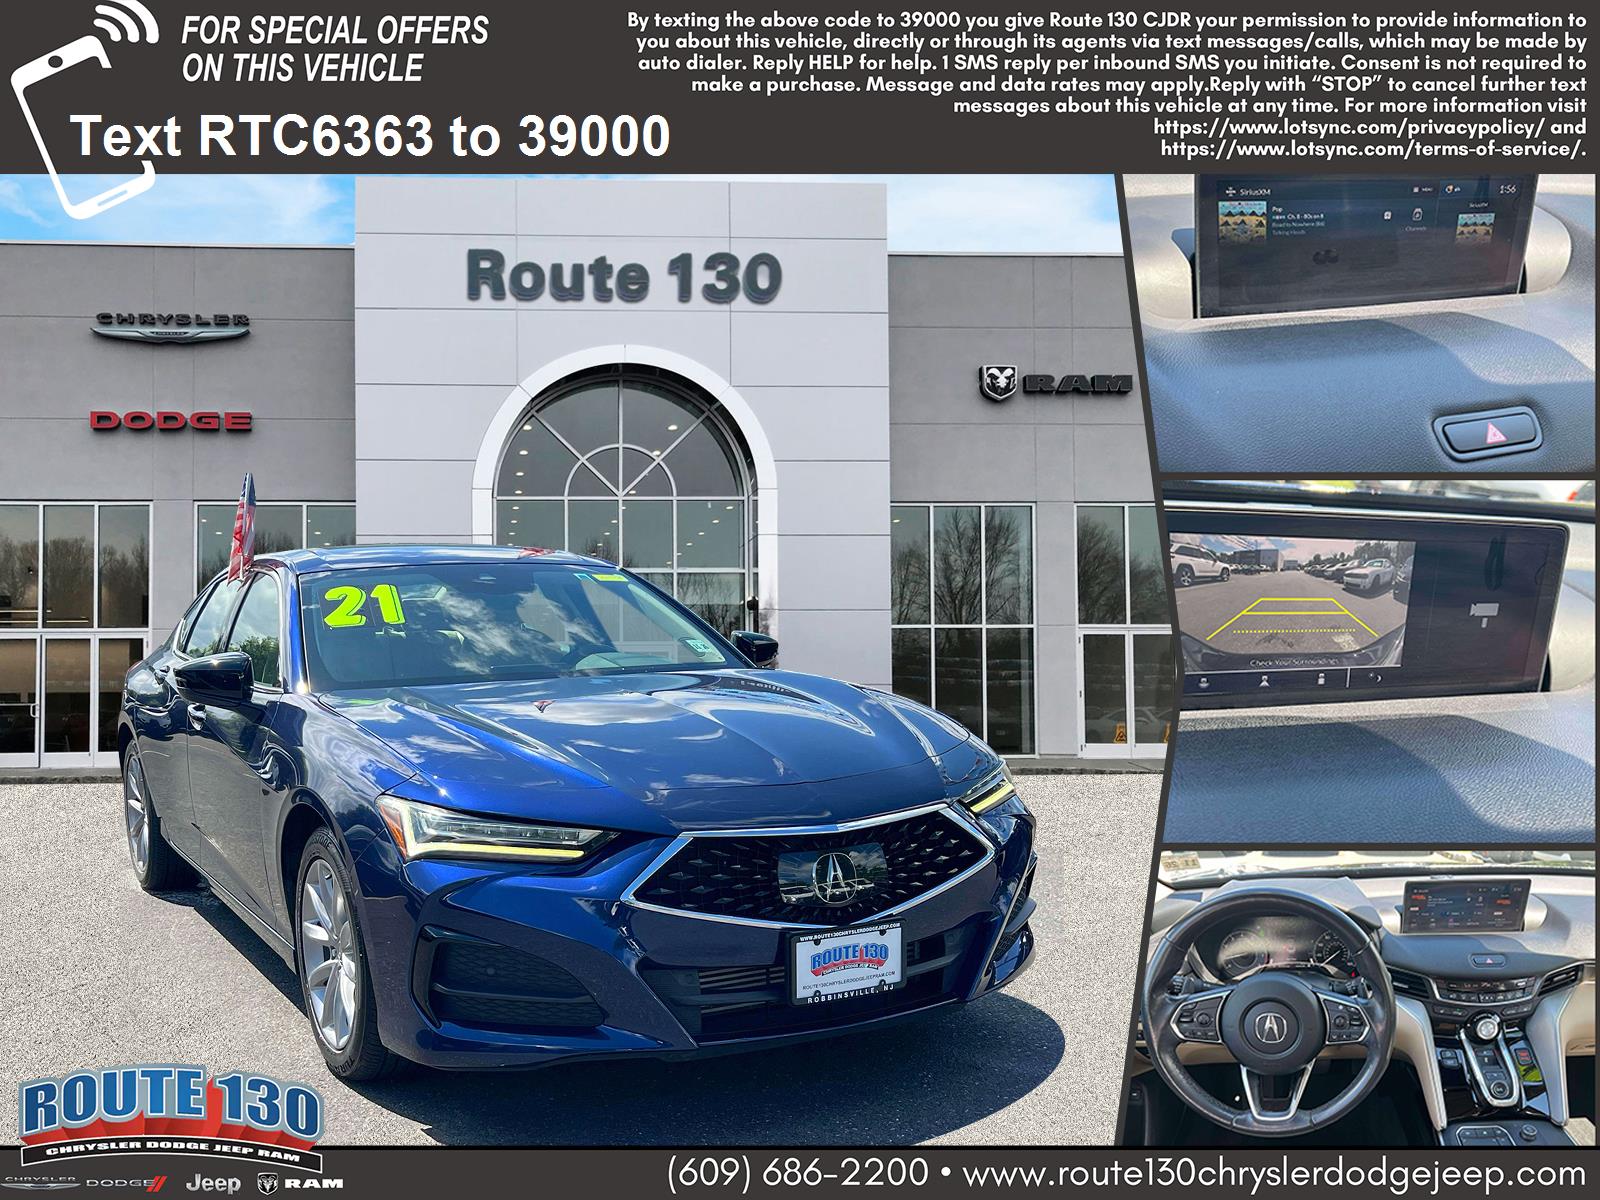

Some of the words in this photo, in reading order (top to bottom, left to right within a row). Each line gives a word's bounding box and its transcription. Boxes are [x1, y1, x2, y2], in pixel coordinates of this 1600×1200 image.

[1500, 185, 1516, 194] 1:56
[467, 248, 650, 302] Route
[668, 252, 783, 304] 130
[96, 312, 250, 326] CHRYSLER
[1023, 374, 1133, 394] RAM
[89, 410, 253, 431] DODGE
[323, 583, 406, 628] 21
[811, 943, 860, 970] ROUTE
[863, 942, 889, 961] 130
[807, 987, 879, 1004] ROBBINSVILLE,
[883, 984, 894, 992] NJ
